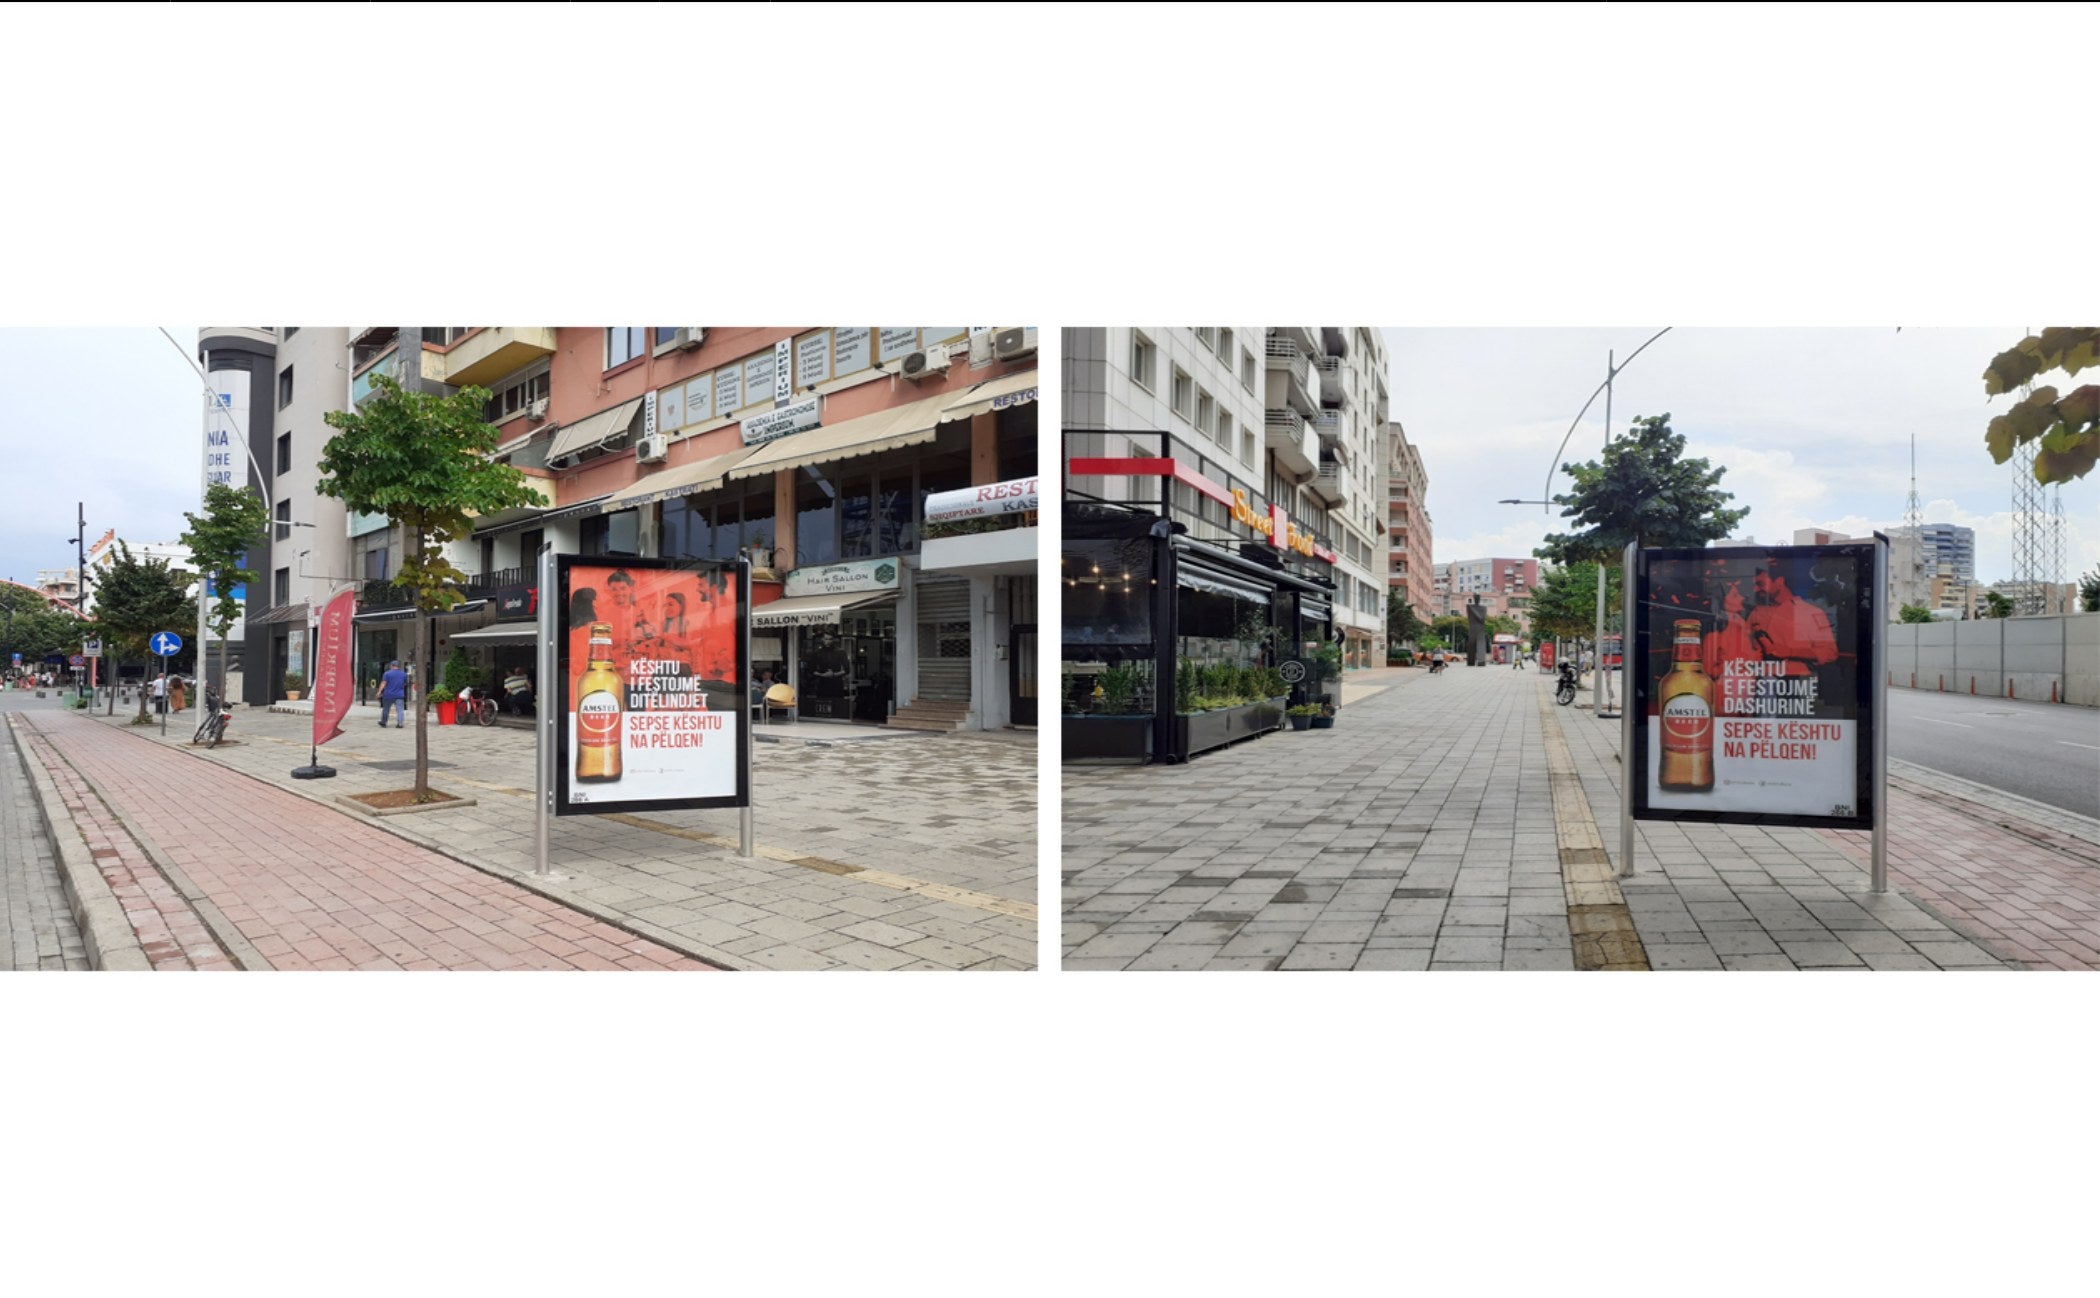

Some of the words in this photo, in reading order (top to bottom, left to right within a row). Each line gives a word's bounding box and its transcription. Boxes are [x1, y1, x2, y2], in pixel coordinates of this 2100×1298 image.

[777, 343, 789, 398] IMPERIUM
[994, 387, 1038, 408] RESTO
[757, 615, 799, 626] SALLON
[630, 658, 680, 675] KËSHTU
[1724, 658, 1786, 677] KËSHTU
[630, 676, 635, 691] I
[637, 674, 701, 692] FESTOJMË
[1724, 679, 1734, 695] E
[1737, 676, 1819, 696] FESTOJMË
[582, 704, 617, 712] AMSTEL
[630, 691, 708, 708] DITËLINDJET
[1724, 696, 1816, 715] DASHURINË
[630, 715, 671, 731] SEPSE
[673, 712, 722, 730] KËSHTU
[1667, 708, 1707, 717] AMSTEL
[1723, 722, 1773, 740] SEPSE
[1777, 720, 1841, 741] KËSHTU
[630, 733, 648, 749] NA
[651, 732, 703, 749] PËLQEN!
[1724, 741, 1745, 758] NA
[1750, 740, 1817, 760] PËLQEN!
